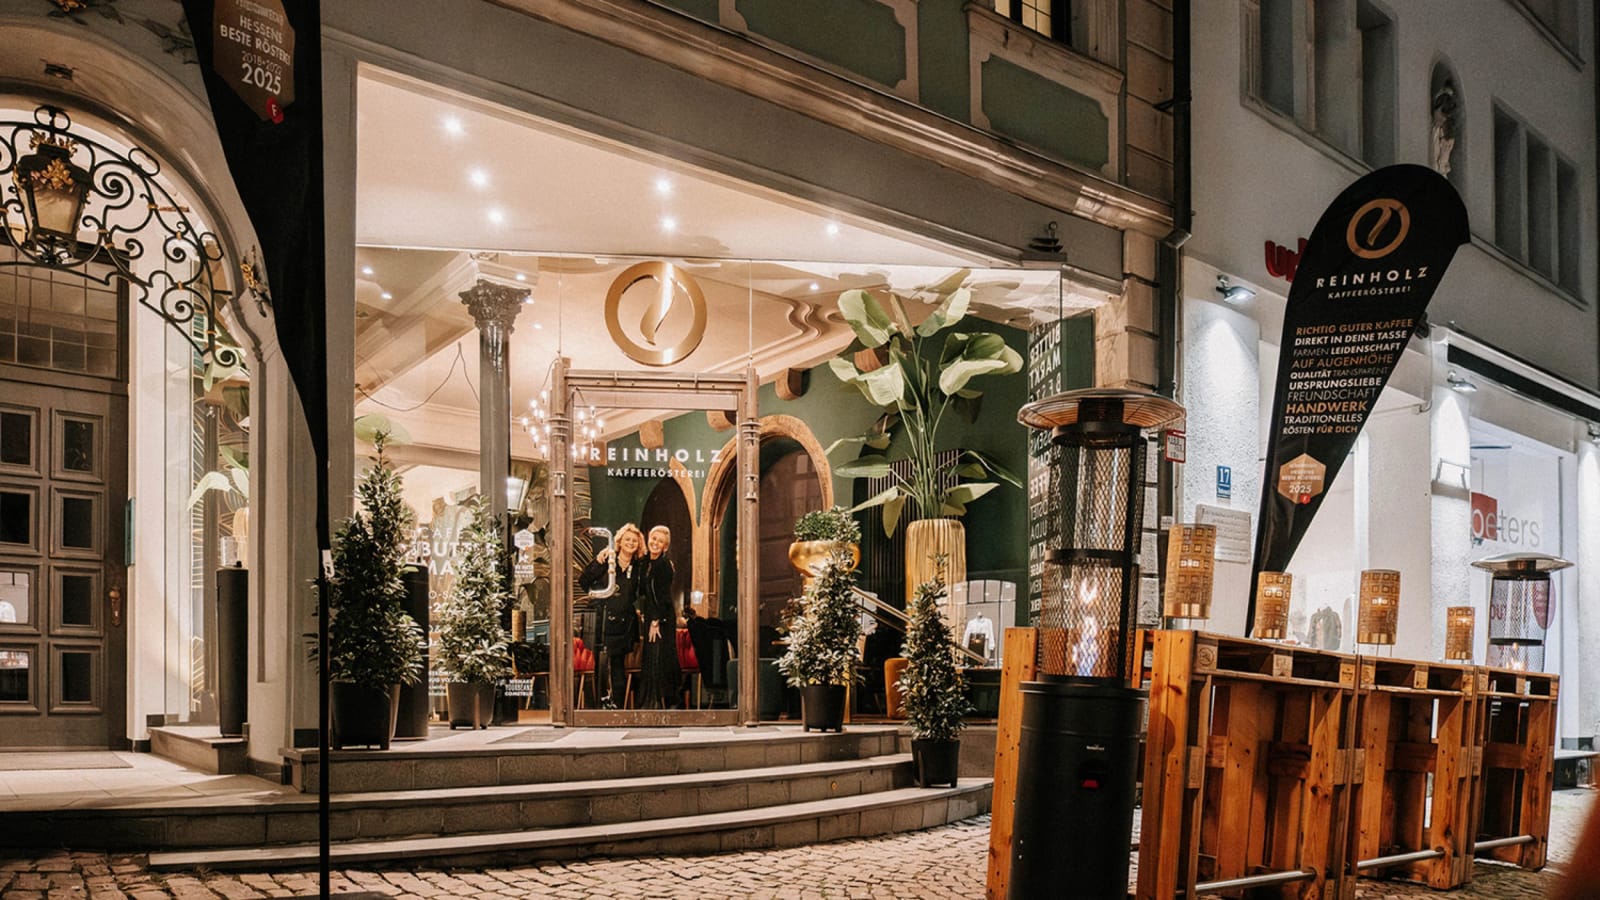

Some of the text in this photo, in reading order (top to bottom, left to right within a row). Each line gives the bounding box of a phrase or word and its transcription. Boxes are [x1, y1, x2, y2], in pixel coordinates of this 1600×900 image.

[220, 24, 251, 47] BESTE
[240, 15, 282, 44] HESSENS
[241, 62, 281, 95] 2025
[1316, 266, 1428, 288] REINHOLZ
[1327, 285, 1411, 299] KAFFEERÖSTEREI
[1296, 318, 1413, 335] RICHTIG GUTER KAFFEE
[1295, 330, 1407, 346] DIREKT IN DEINE TASSE
[1331, 342, 1401, 355] LEIDENSCHAFT
[1292, 352, 1393, 368] AUF AUGENHÖHE
[1290, 369, 1332, 380] QUALITÄT
[1289, 377, 1382, 391] URSPRUNGSLIEBE
[1287, 387, 1376, 401] FREUNDSCHAFT
[1286, 401, 1368, 414] HANDWERK
[1284, 413, 1363, 425] TRADITIONELLES
[1282, 425, 1358, 435] RÖSTEN FÜR DICH
[590, 447, 721, 462] REINHOLZ
[607, 467, 705, 478] KAFFEERÖSTEREI
[1219, 467, 1230, 484] 17
[1289, 485, 1312, 494] 2025
